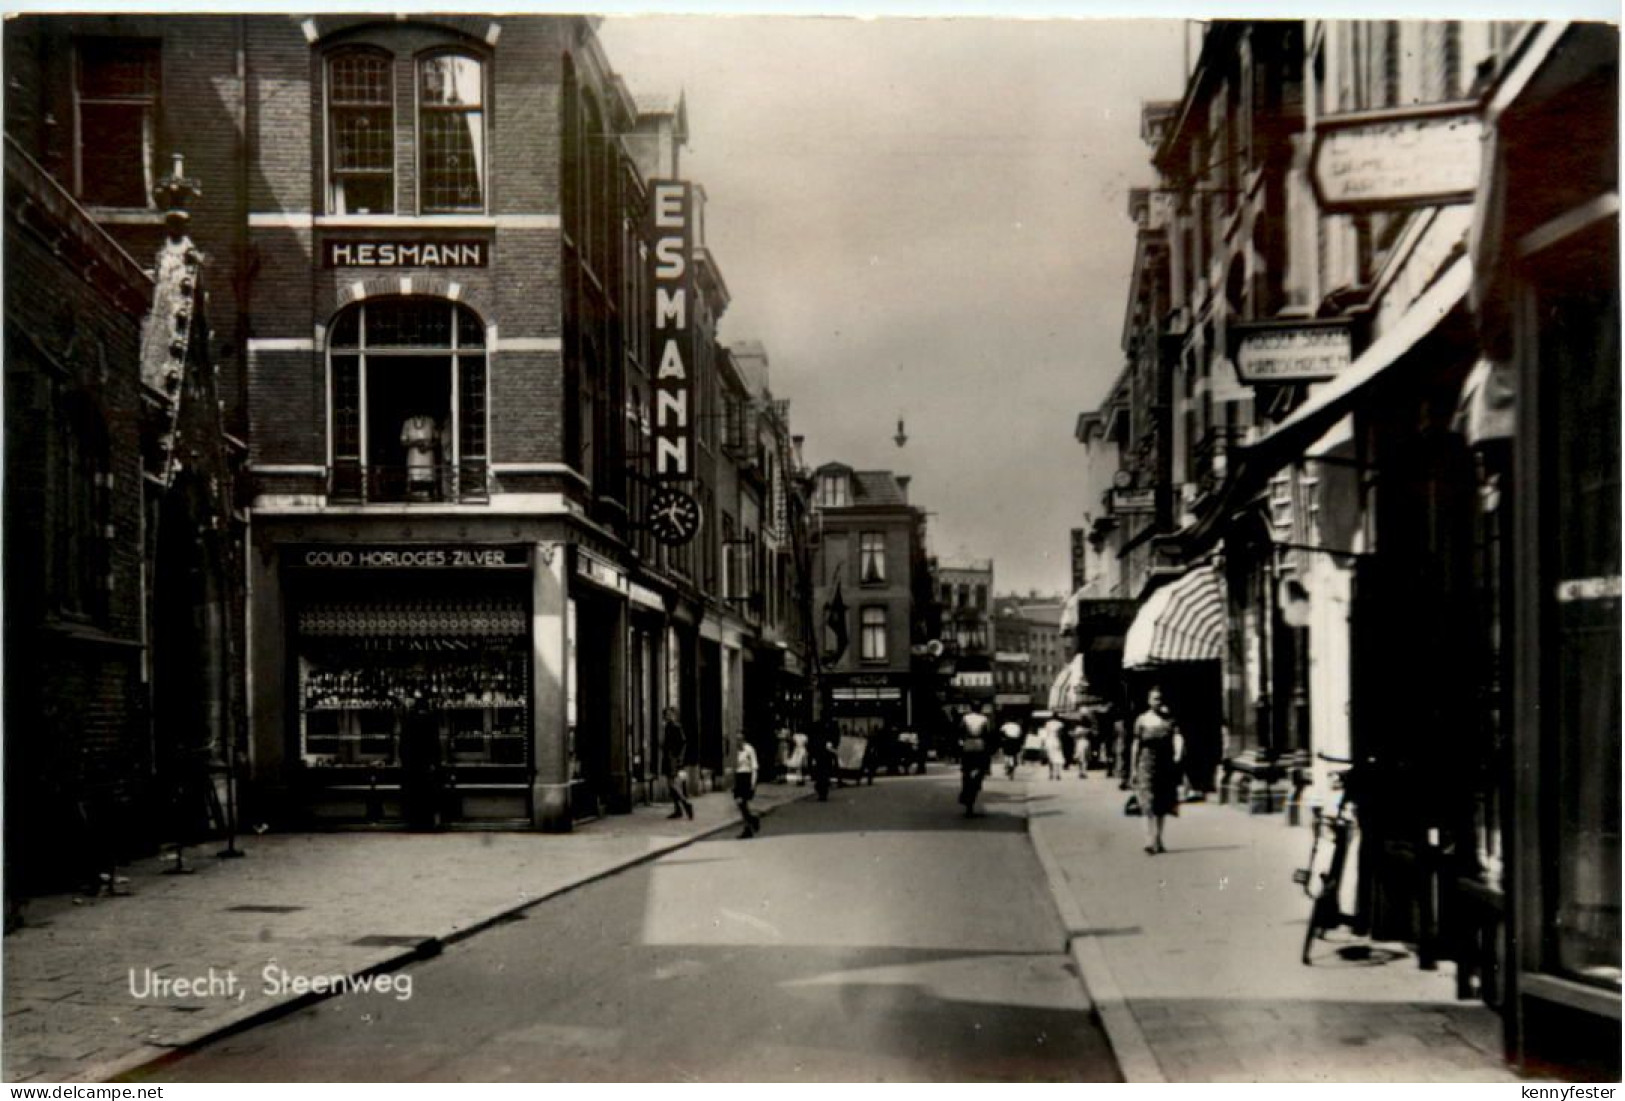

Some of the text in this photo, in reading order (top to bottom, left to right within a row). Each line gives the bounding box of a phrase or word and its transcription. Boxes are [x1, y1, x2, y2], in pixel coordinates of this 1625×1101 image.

[332, 243, 479, 265] H.ESMANN
[655, 185, 687, 474] ESMANN
[305, 550, 353, 565] GOUD
